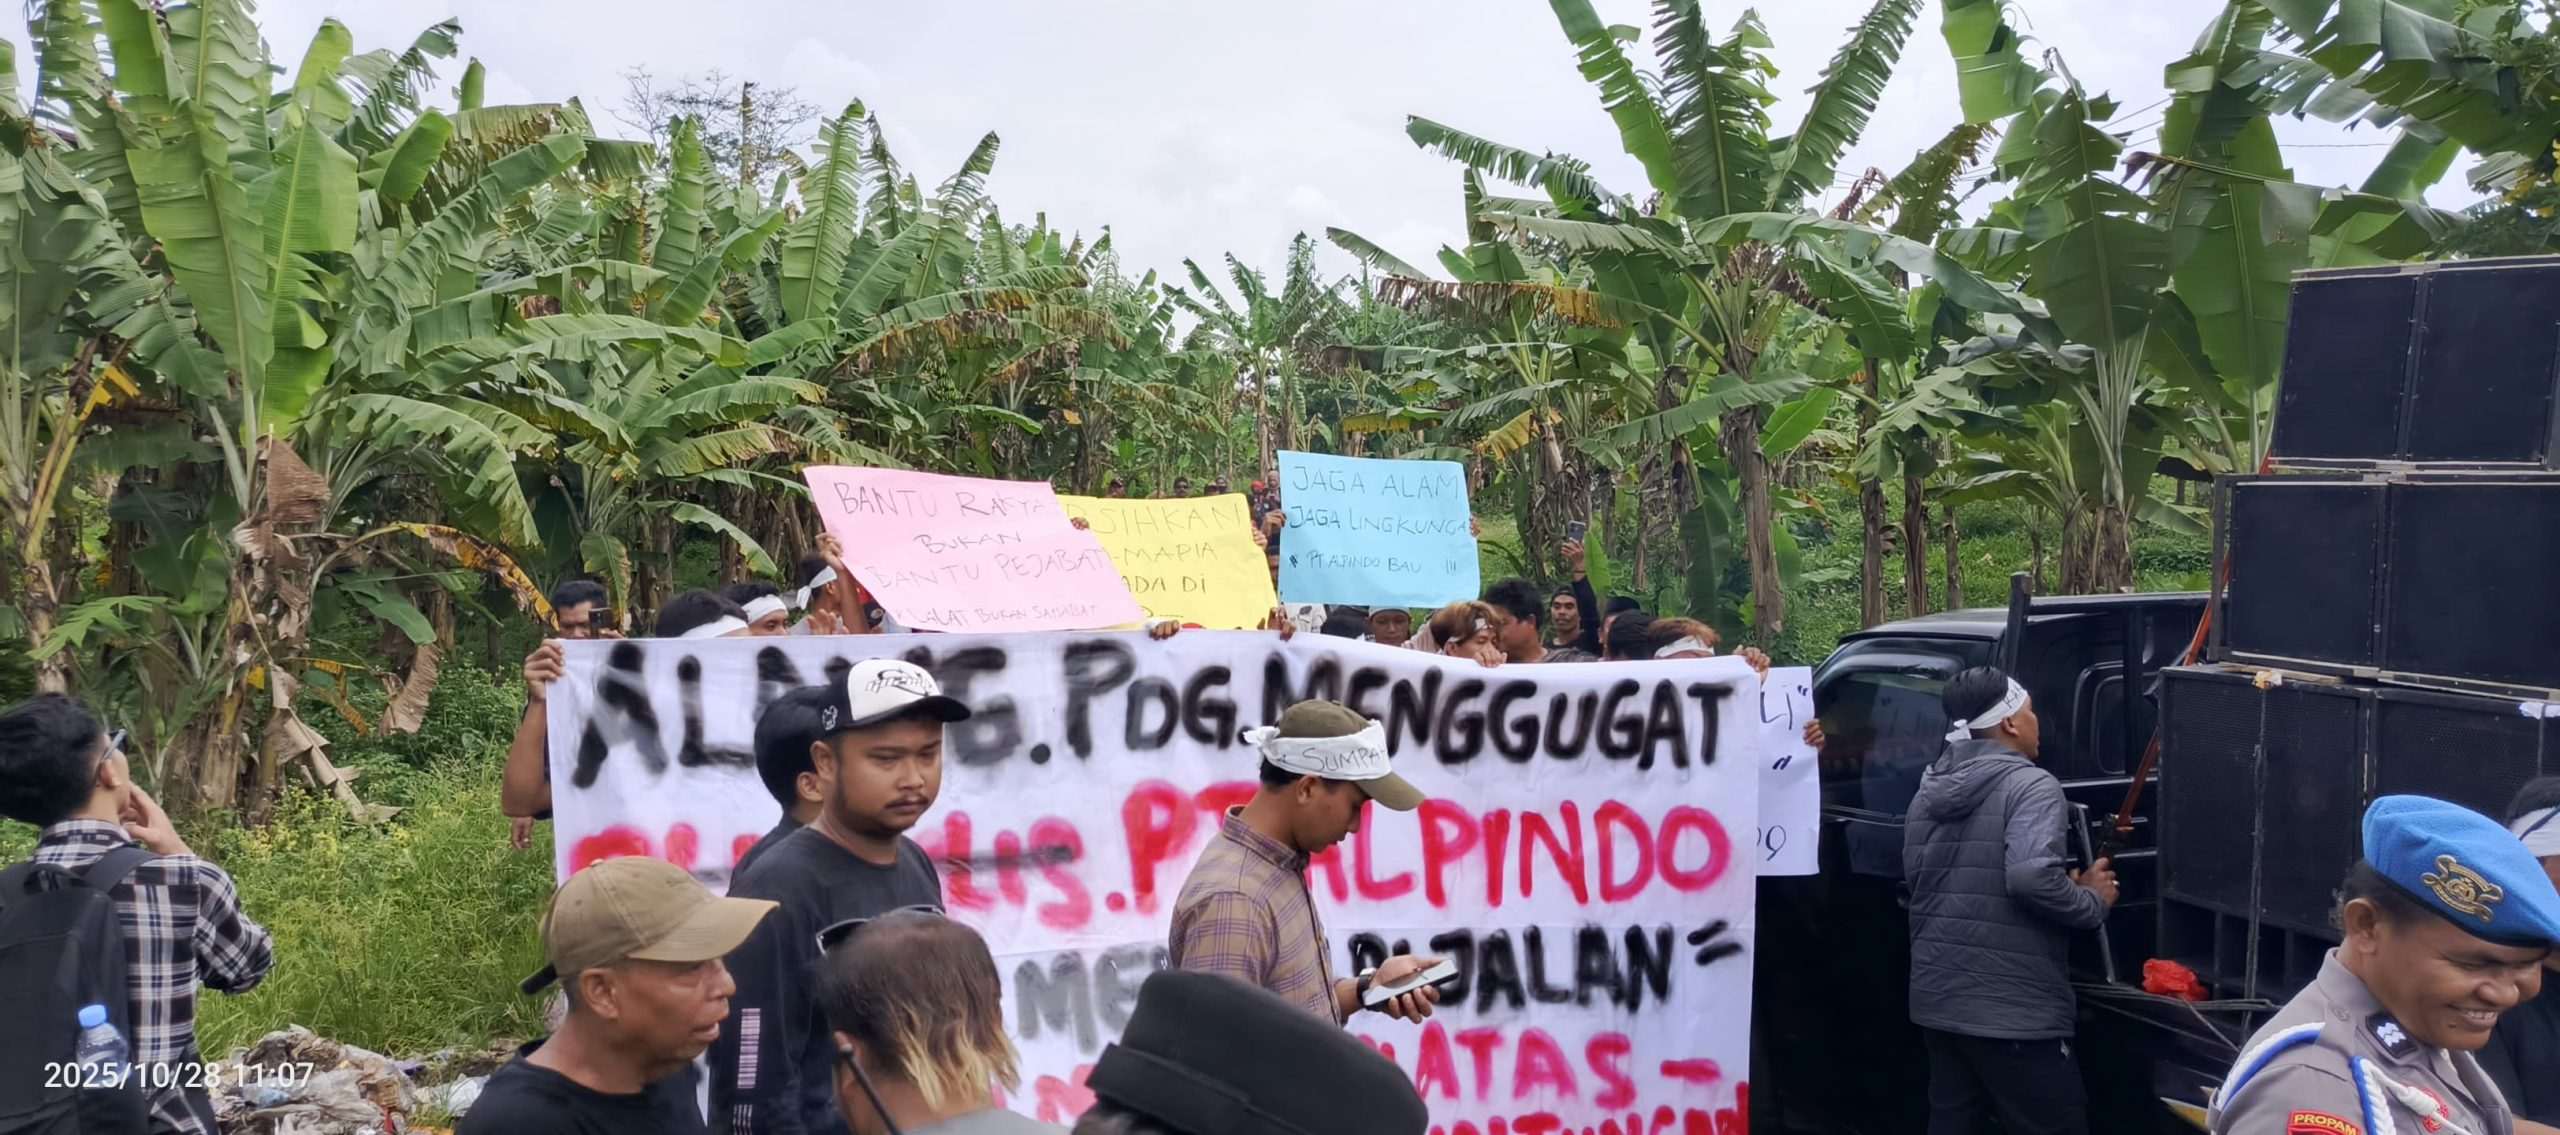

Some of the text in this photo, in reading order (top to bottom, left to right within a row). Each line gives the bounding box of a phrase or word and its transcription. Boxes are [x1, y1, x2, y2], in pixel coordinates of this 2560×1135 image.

[1293, 465, 1459, 501] JAGA ALAM
[833, 482, 939, 519] BANTU
[1289, 505, 1342, 530] JAGA
[913, 532, 1022, 555] BUKAN
[865, 560, 981, 590] BANTU
[1387, 558, 1423, 574] BAU
[2293, 1112, 2358, 1135] PROPAM
